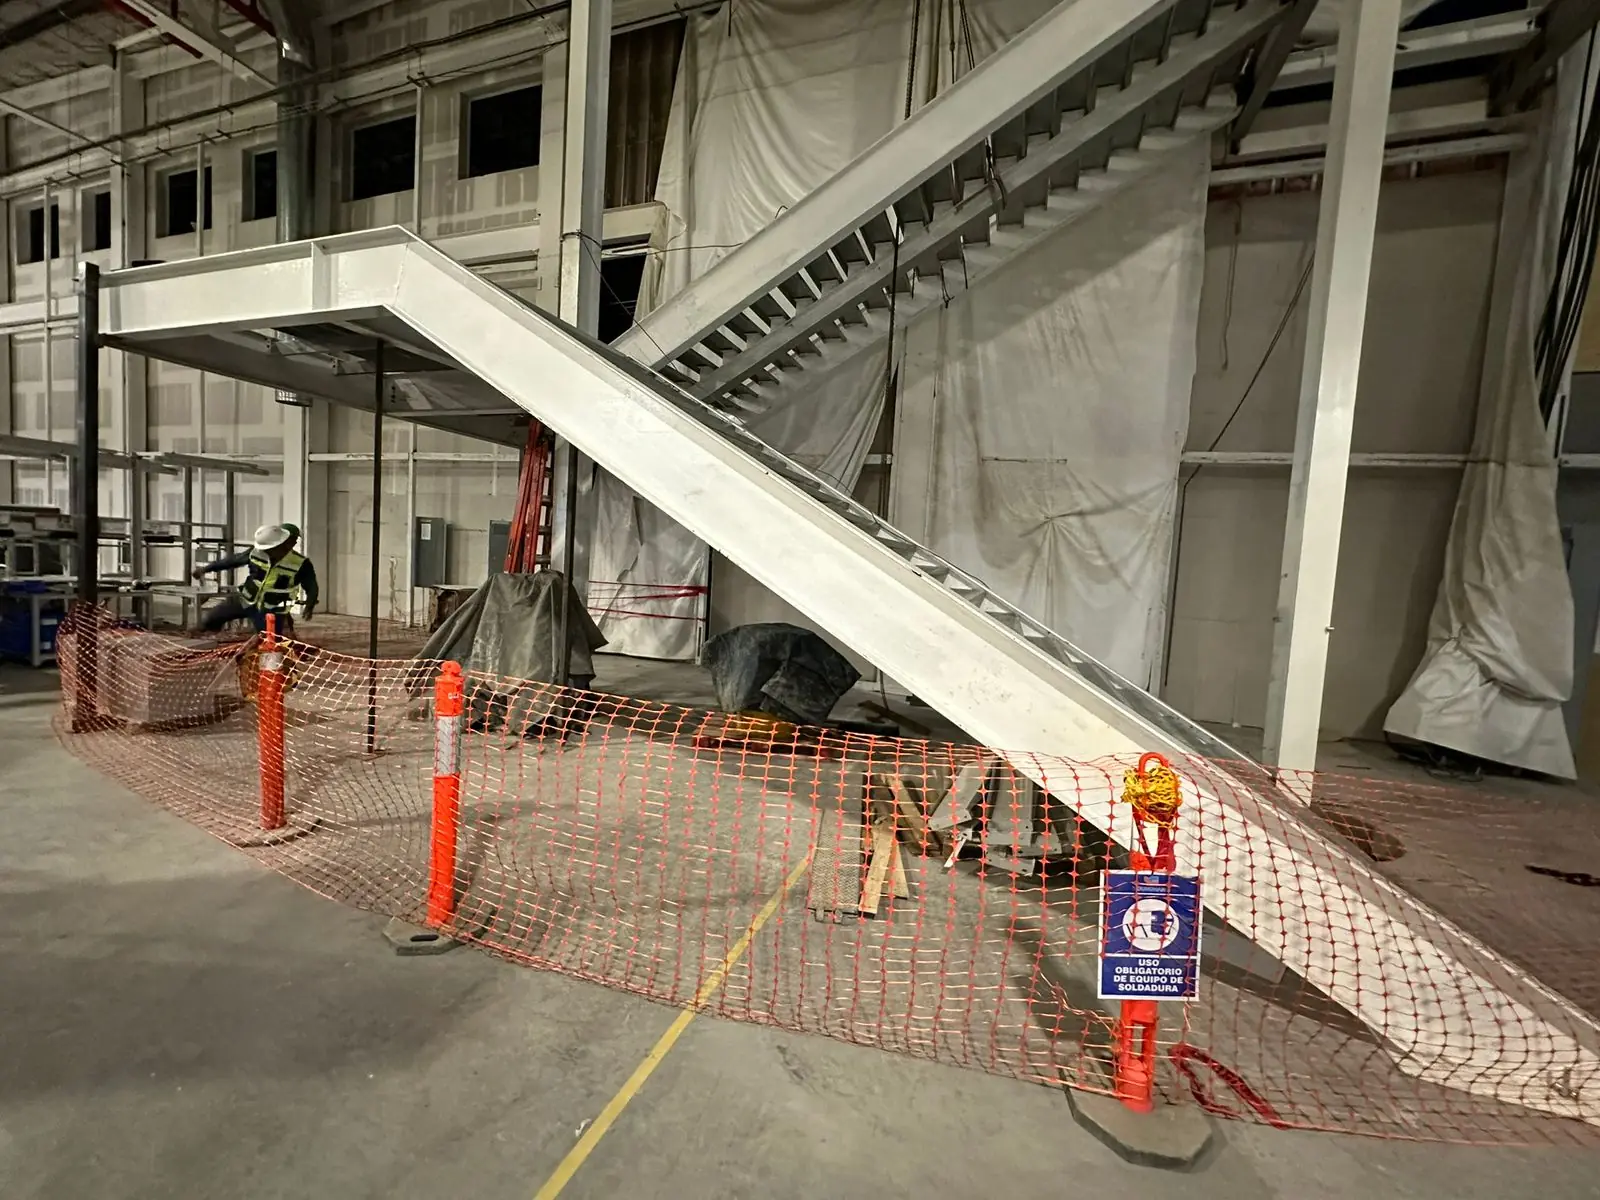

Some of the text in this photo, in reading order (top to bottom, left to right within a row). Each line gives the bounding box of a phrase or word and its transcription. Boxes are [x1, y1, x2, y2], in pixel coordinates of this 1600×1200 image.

[1115, 967, 1182, 975] OBLIGATORIO
[1129, 975, 1167, 983] EQUIPO
[1118, 984, 1178, 992] SOLDADURA
